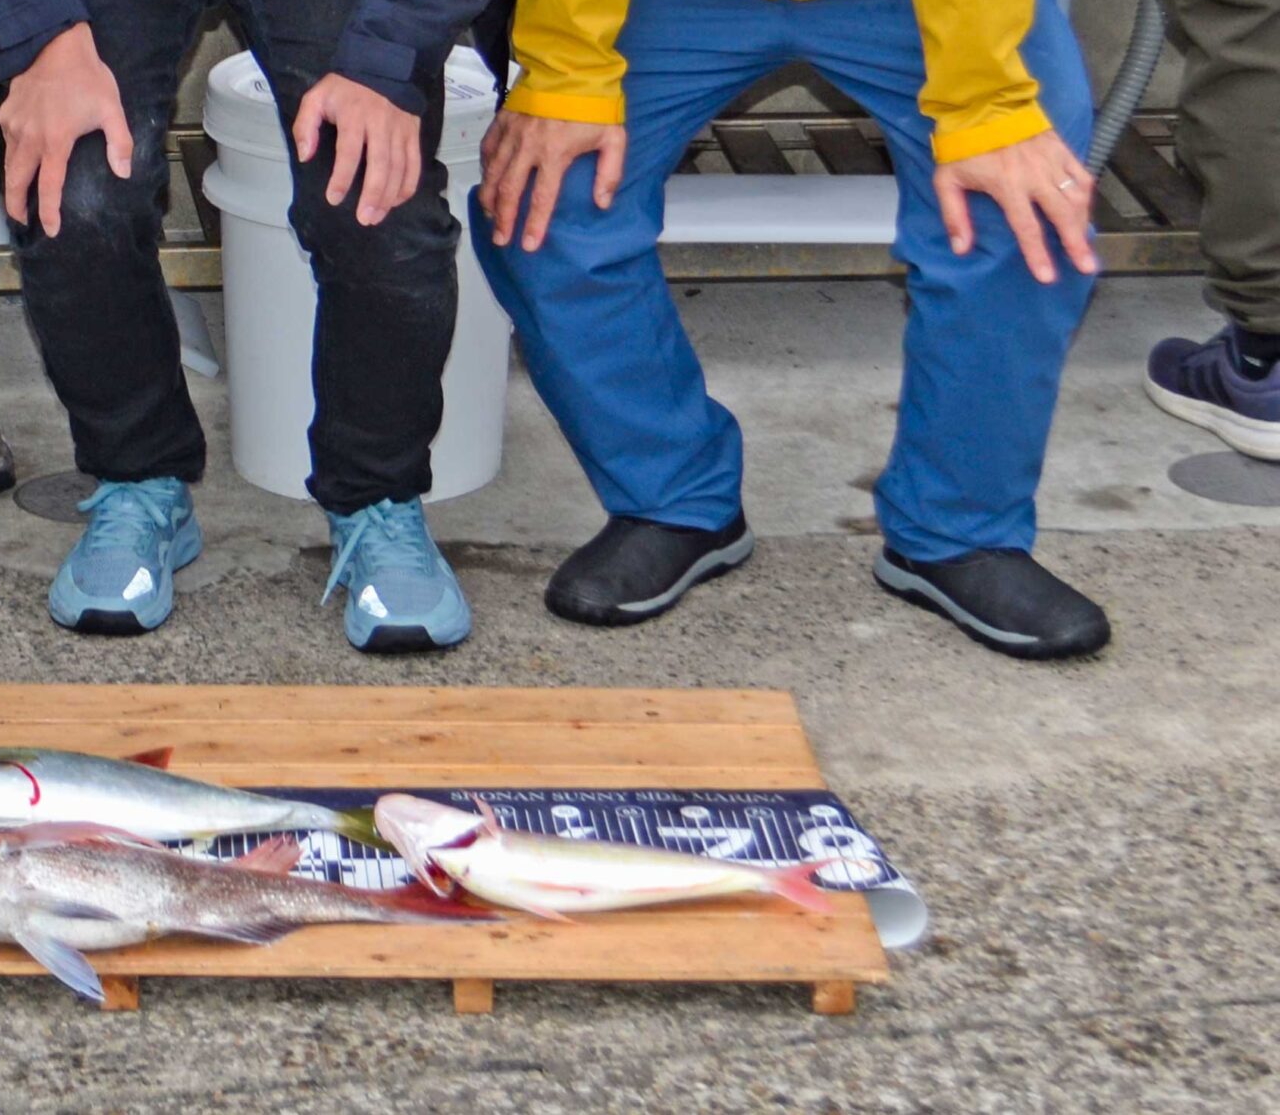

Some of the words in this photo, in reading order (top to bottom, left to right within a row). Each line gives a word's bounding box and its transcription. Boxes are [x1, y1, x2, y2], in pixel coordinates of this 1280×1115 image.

[551, 790, 627, 802] SUNNY
[635, 790, 685, 802] SIDE
[691, 790, 786, 803] MARINA
